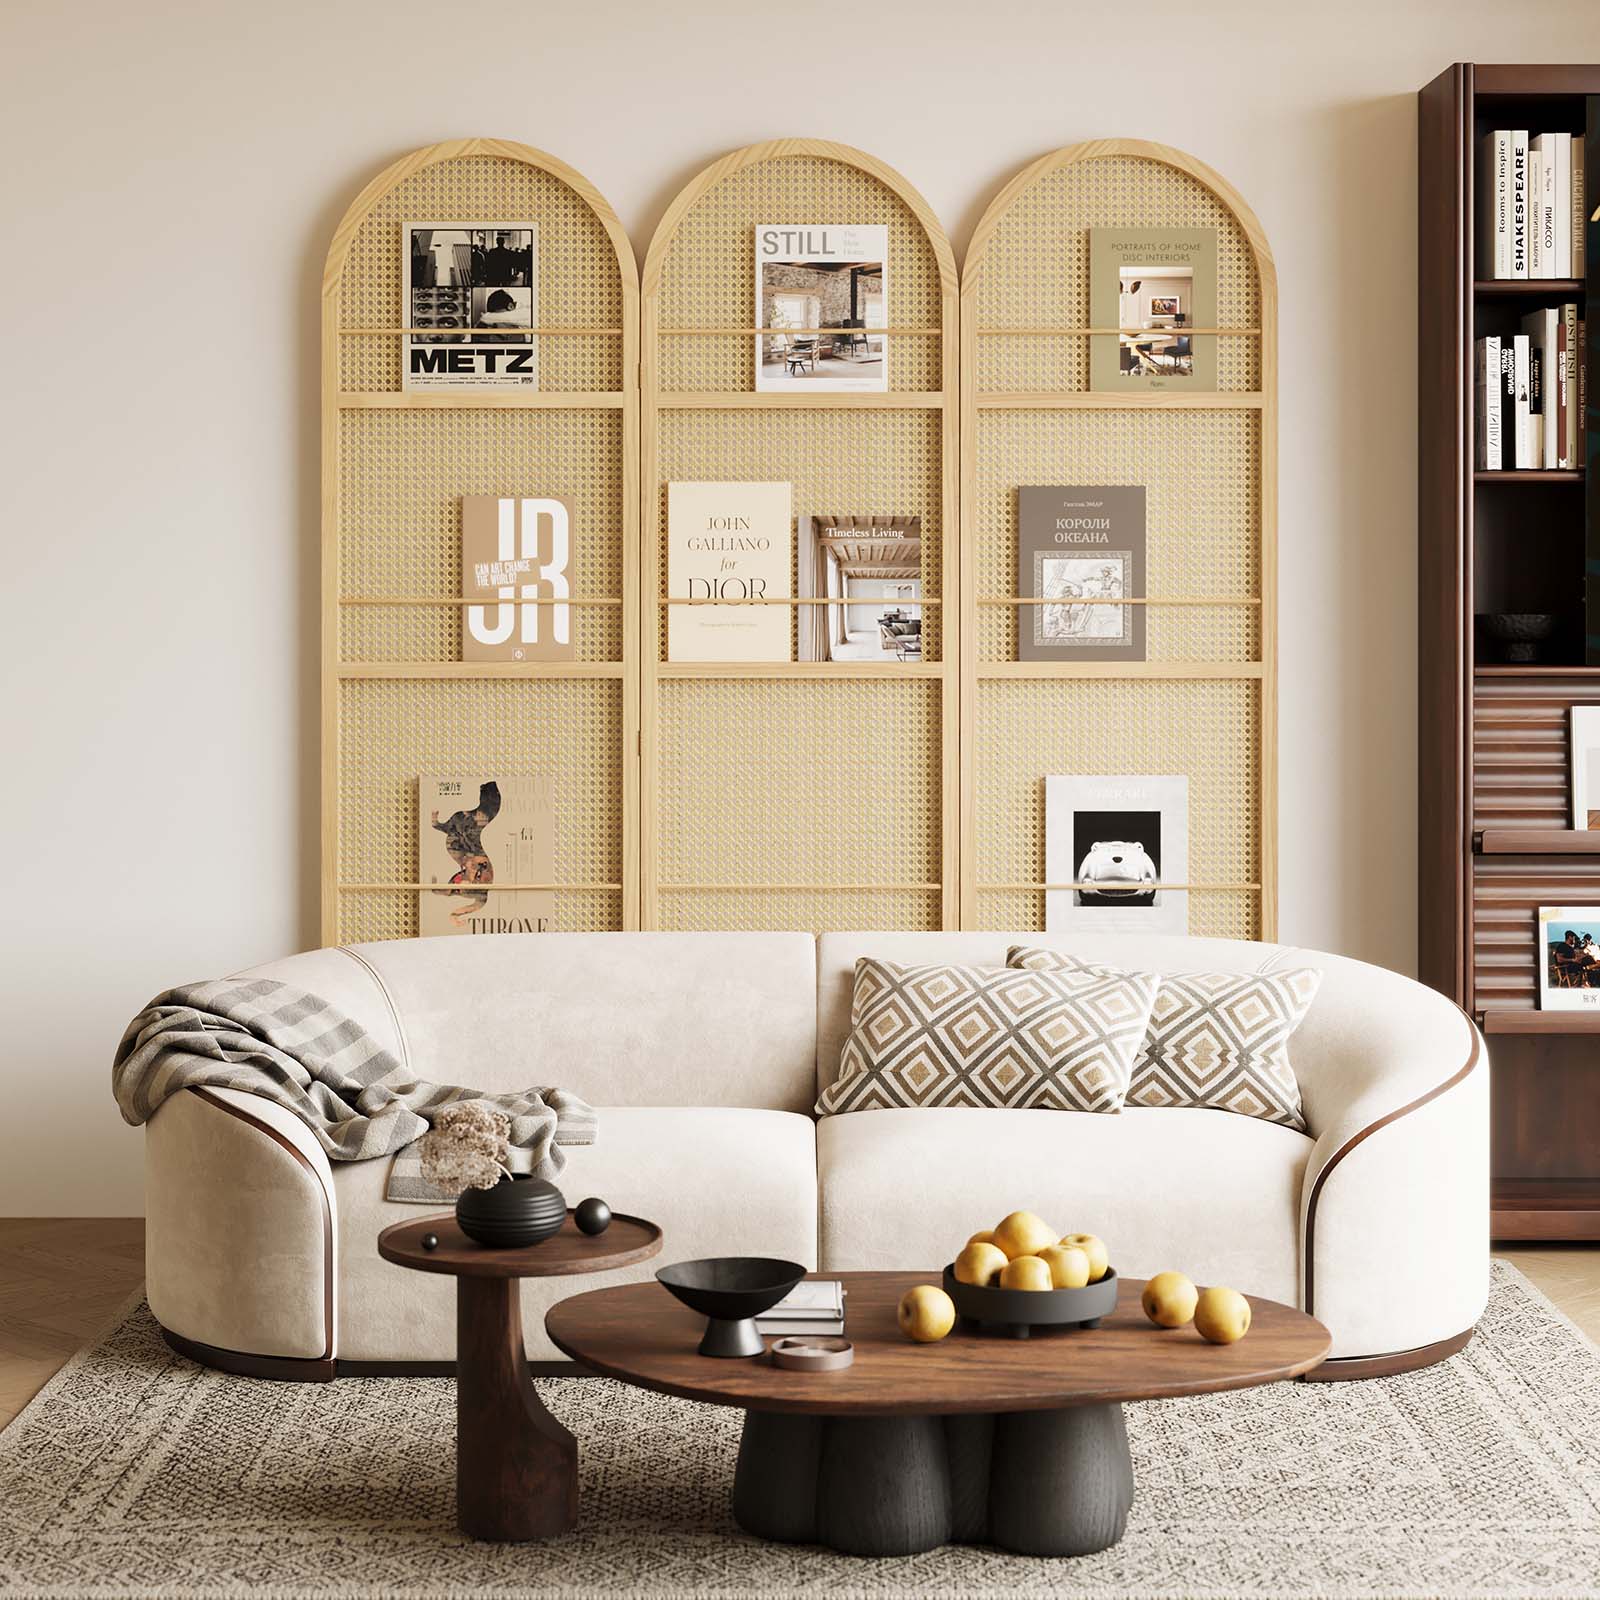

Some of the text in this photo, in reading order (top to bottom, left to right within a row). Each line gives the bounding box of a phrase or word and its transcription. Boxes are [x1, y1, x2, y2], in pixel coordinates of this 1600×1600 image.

[1498, 139, 1507, 233] Rooms to Inspire
[1515, 147, 1524, 271] SHAKESPEARE
[1544, 206, 1552, 248] ПИКАССО
[762, 231, 836, 255] STILL
[1111, 243, 1201, 251] PORTRAITS OF HOME
[1122, 254, 1191, 262] DISC INTERIORS
[1567, 308, 1575, 379] LOST FISH
[410, 349, 533, 373] METZ
[707, 517, 750, 530] JOHN
[1056, 518, 1110, 529] КОРОЛИ
[826, 527, 904, 539] Timeless Living
[1054, 532, 1109, 543] ОКЕАНА
[687, 537, 770, 551] GALLIANO
[468, 498, 570, 645] JR
[474, 559, 531, 576] CAN ART CHANGE
[720, 556, 738, 572] for
[475, 575, 490, 587] THE
[688, 577, 768, 606] DIOR
